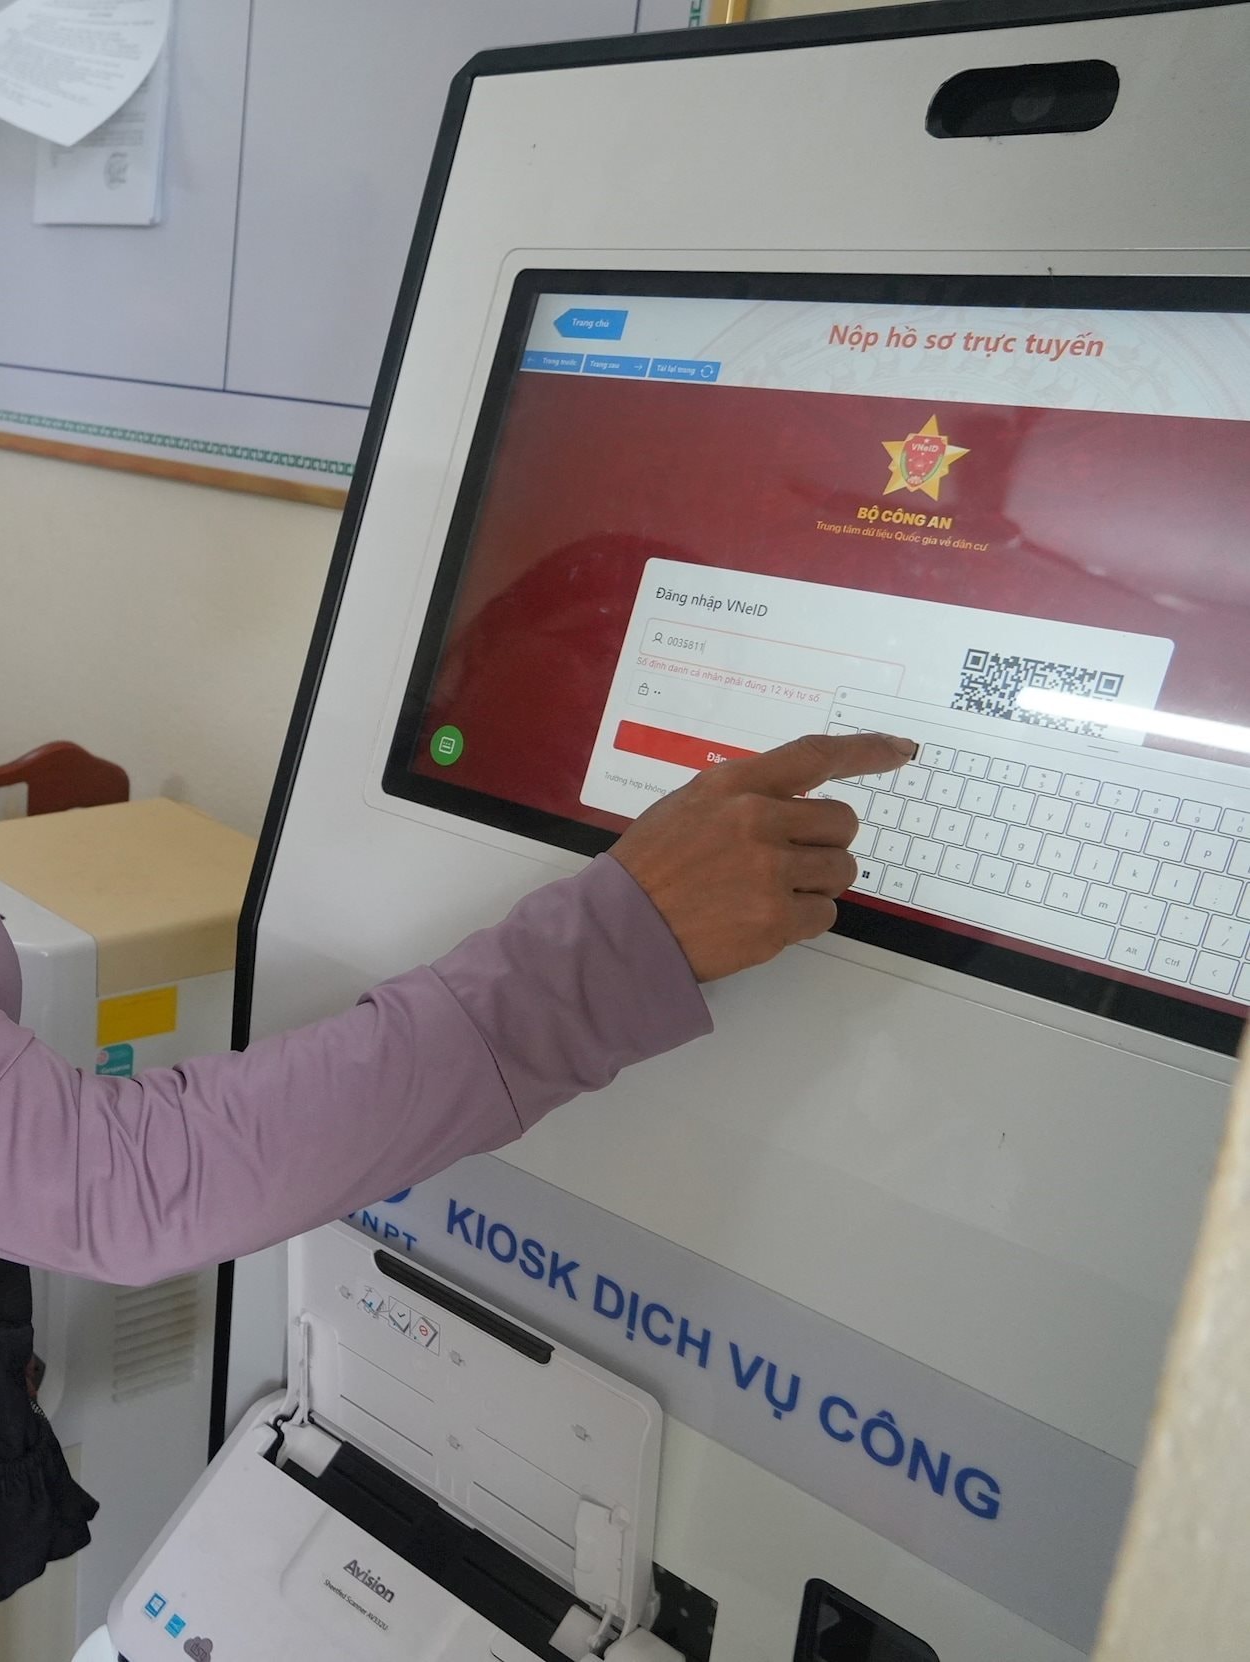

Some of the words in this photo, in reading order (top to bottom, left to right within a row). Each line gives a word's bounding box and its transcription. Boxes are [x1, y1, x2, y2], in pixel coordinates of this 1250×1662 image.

[572, 318, 593, 330] Trang
[828, 324, 879, 352] Nộp
[885, 325, 918, 349] hồ
[924, 332, 957, 350] sơ
[962, 331, 1017, 358] trực
[1025, 332, 1104, 362] tuyến
[911, 443, 940, 453] VNeID
[857, 505, 880, 524] BỘ
[881, 508, 926, 526] CÔNG
[927, 516, 953, 530] AN
[816, 521, 841, 534] Trung
[895, 530, 921, 544] Quốc
[922, 535, 937, 546] gia
[655, 586, 688, 607] Đăng
[691, 590, 723, 612] nhập
[727, 599, 768, 618] VNeID
[668, 663, 688, 675] danh
[770, 685, 780, 695] 12
[1125, 946, 1137, 955] Alt
[1165, 957, 1180, 967] Ctrl
[348, 1210, 418, 1251] NPT
[445, 1197, 581, 1301] KIOSK
[593, 1272, 710, 1369] DỊCH
[727, 1341, 802, 1421] VỤ
[818, 1393, 1004, 1521] CÔNG
[343, 1559, 395, 1603] Avision
